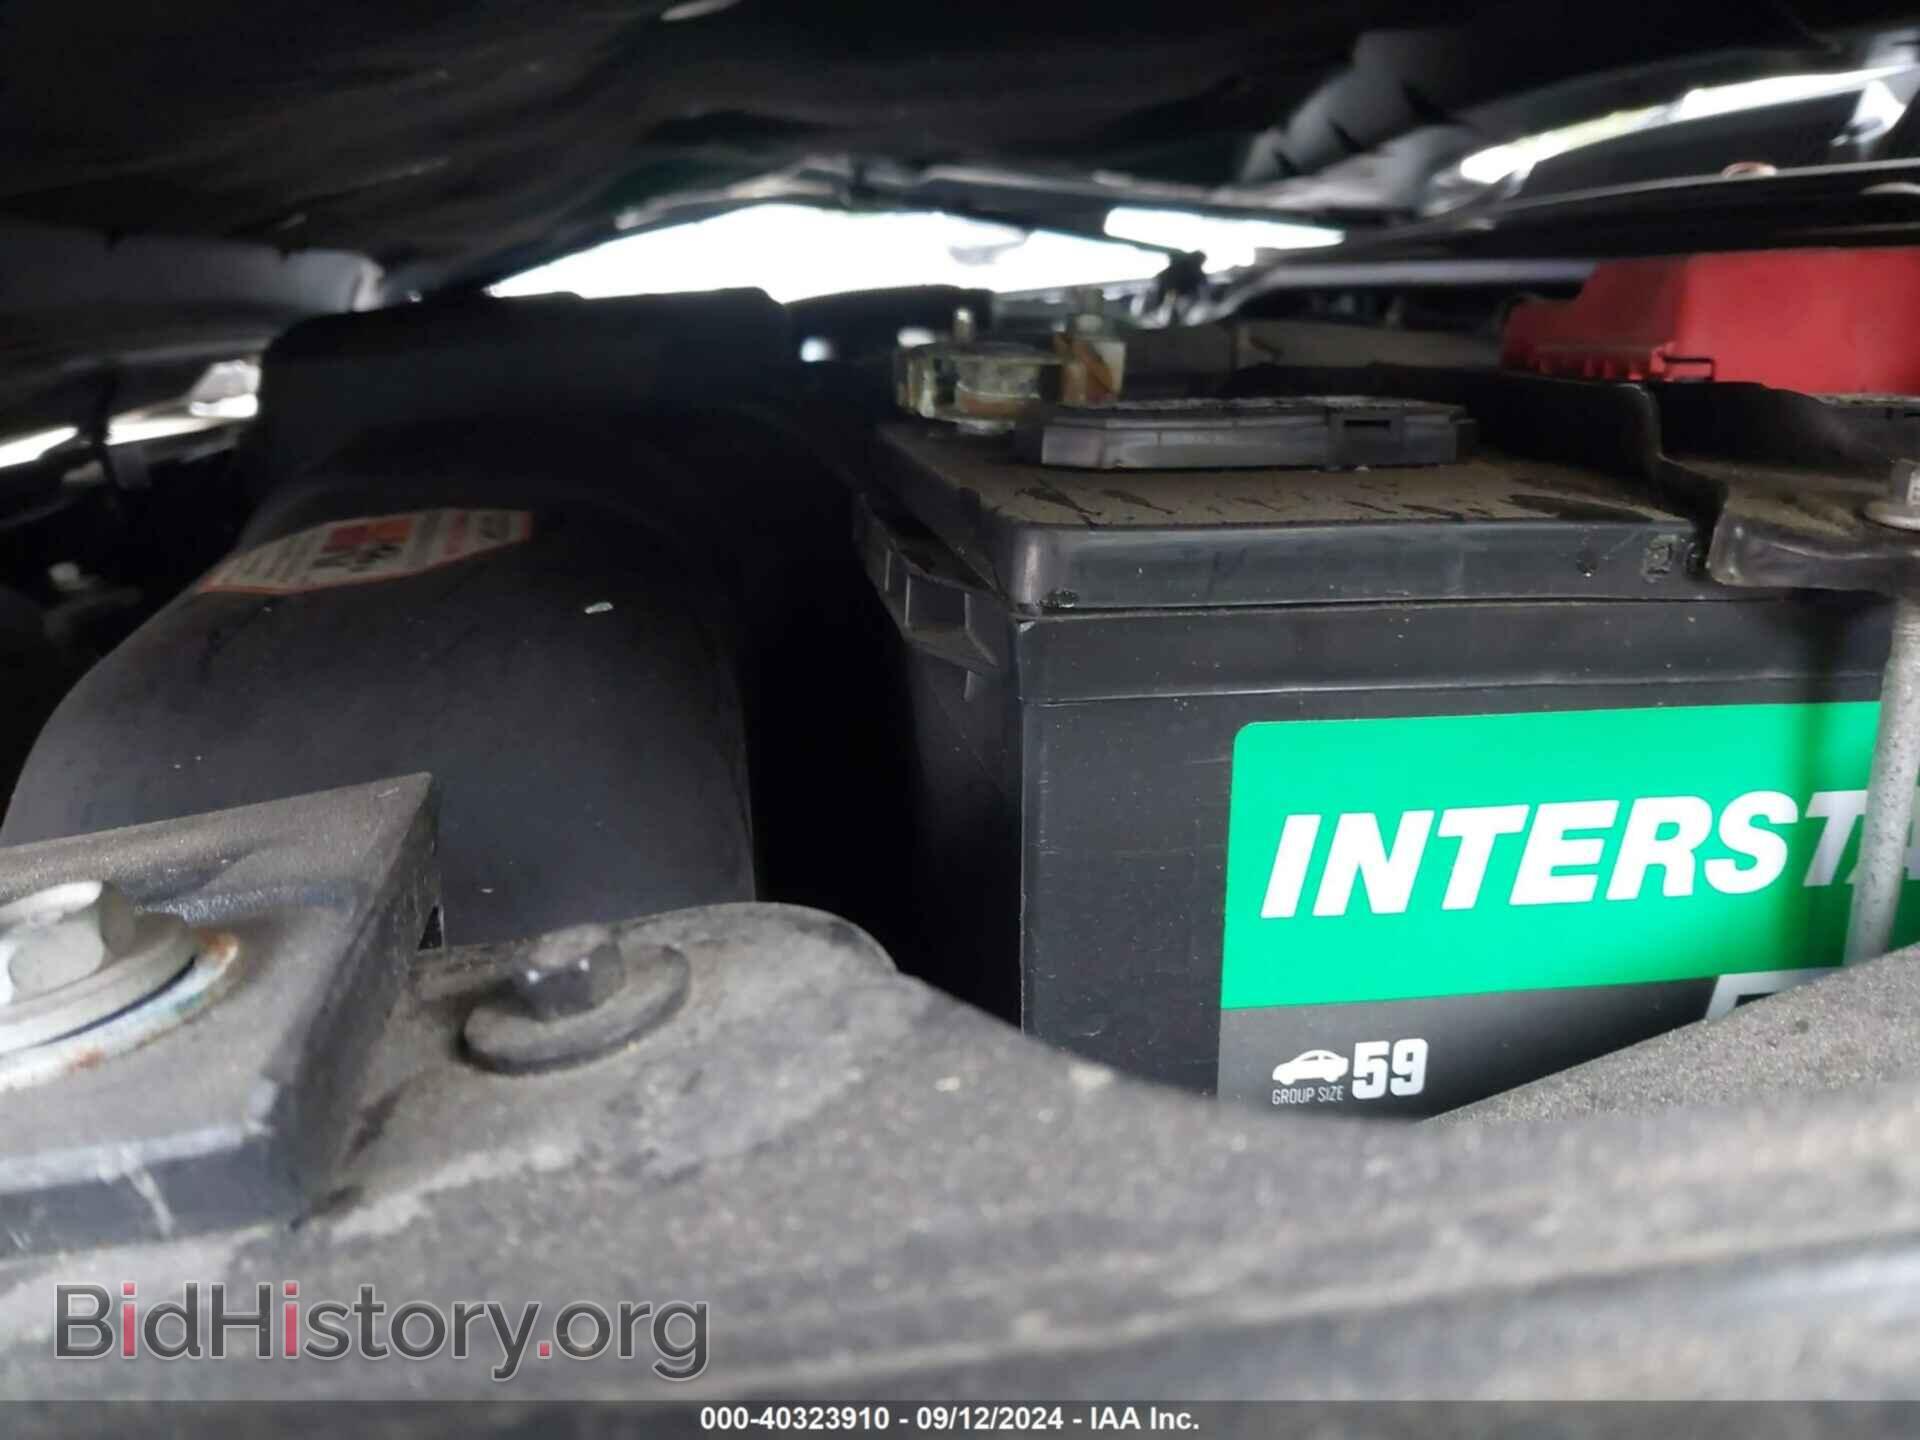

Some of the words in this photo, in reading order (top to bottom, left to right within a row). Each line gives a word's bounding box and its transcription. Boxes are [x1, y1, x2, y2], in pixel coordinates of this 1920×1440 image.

[1351, 1037, 1429, 1100] 59
[1271, 1086, 1316, 1105] GROUP
[1317, 1084, 1345, 1103] SIZE
